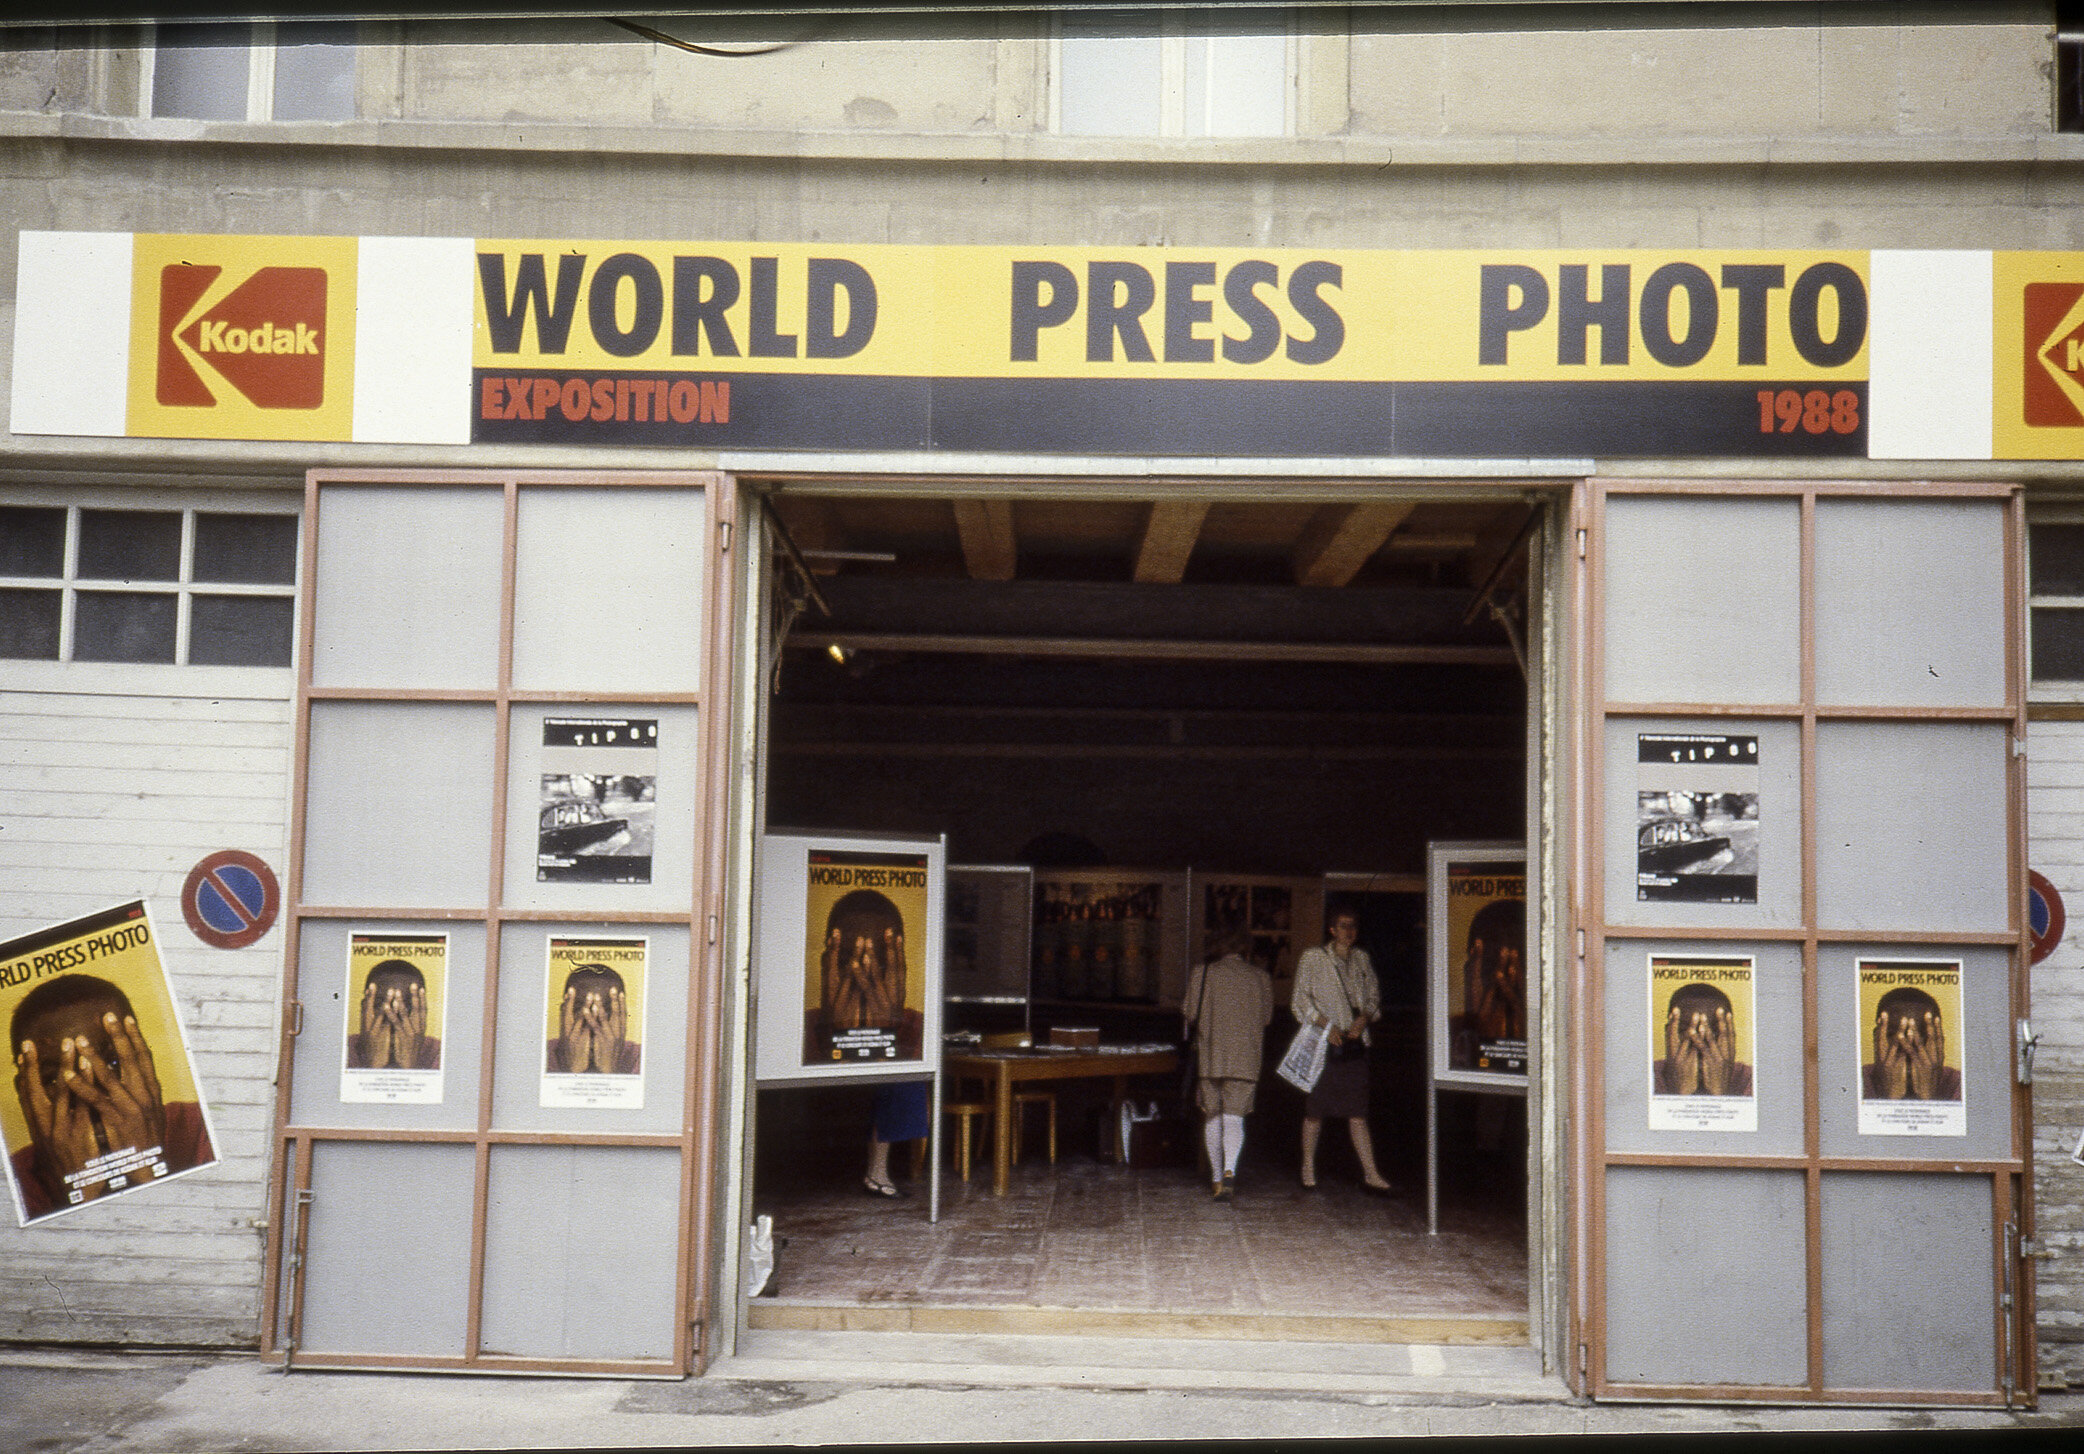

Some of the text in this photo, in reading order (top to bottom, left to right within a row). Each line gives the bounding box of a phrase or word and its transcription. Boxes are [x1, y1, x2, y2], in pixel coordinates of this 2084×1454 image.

[478, 253, 1868, 368] WORLD PRESS PHOTO
[199, 320, 319, 356] Kodak
[481, 377, 730, 424] EXPOSITION
[1756, 389, 1860, 435] 1988
[810, 868, 927, 888] WORLD PRESS PHOTO
[1449, 878, 1493, 896] WORLD
[33, 943, 86, 978] PRESS
[88, 924, 149, 960] PHOTO
[353, 945, 445, 957] WORLD PRESS PHOTO
[551, 949, 645, 961] WORLD PRESS PHOTO
[1653, 968, 1751, 981] WORLD PRESS PHOTO
[1860, 972, 1959, 985] WORLD PRESS PHOTO
